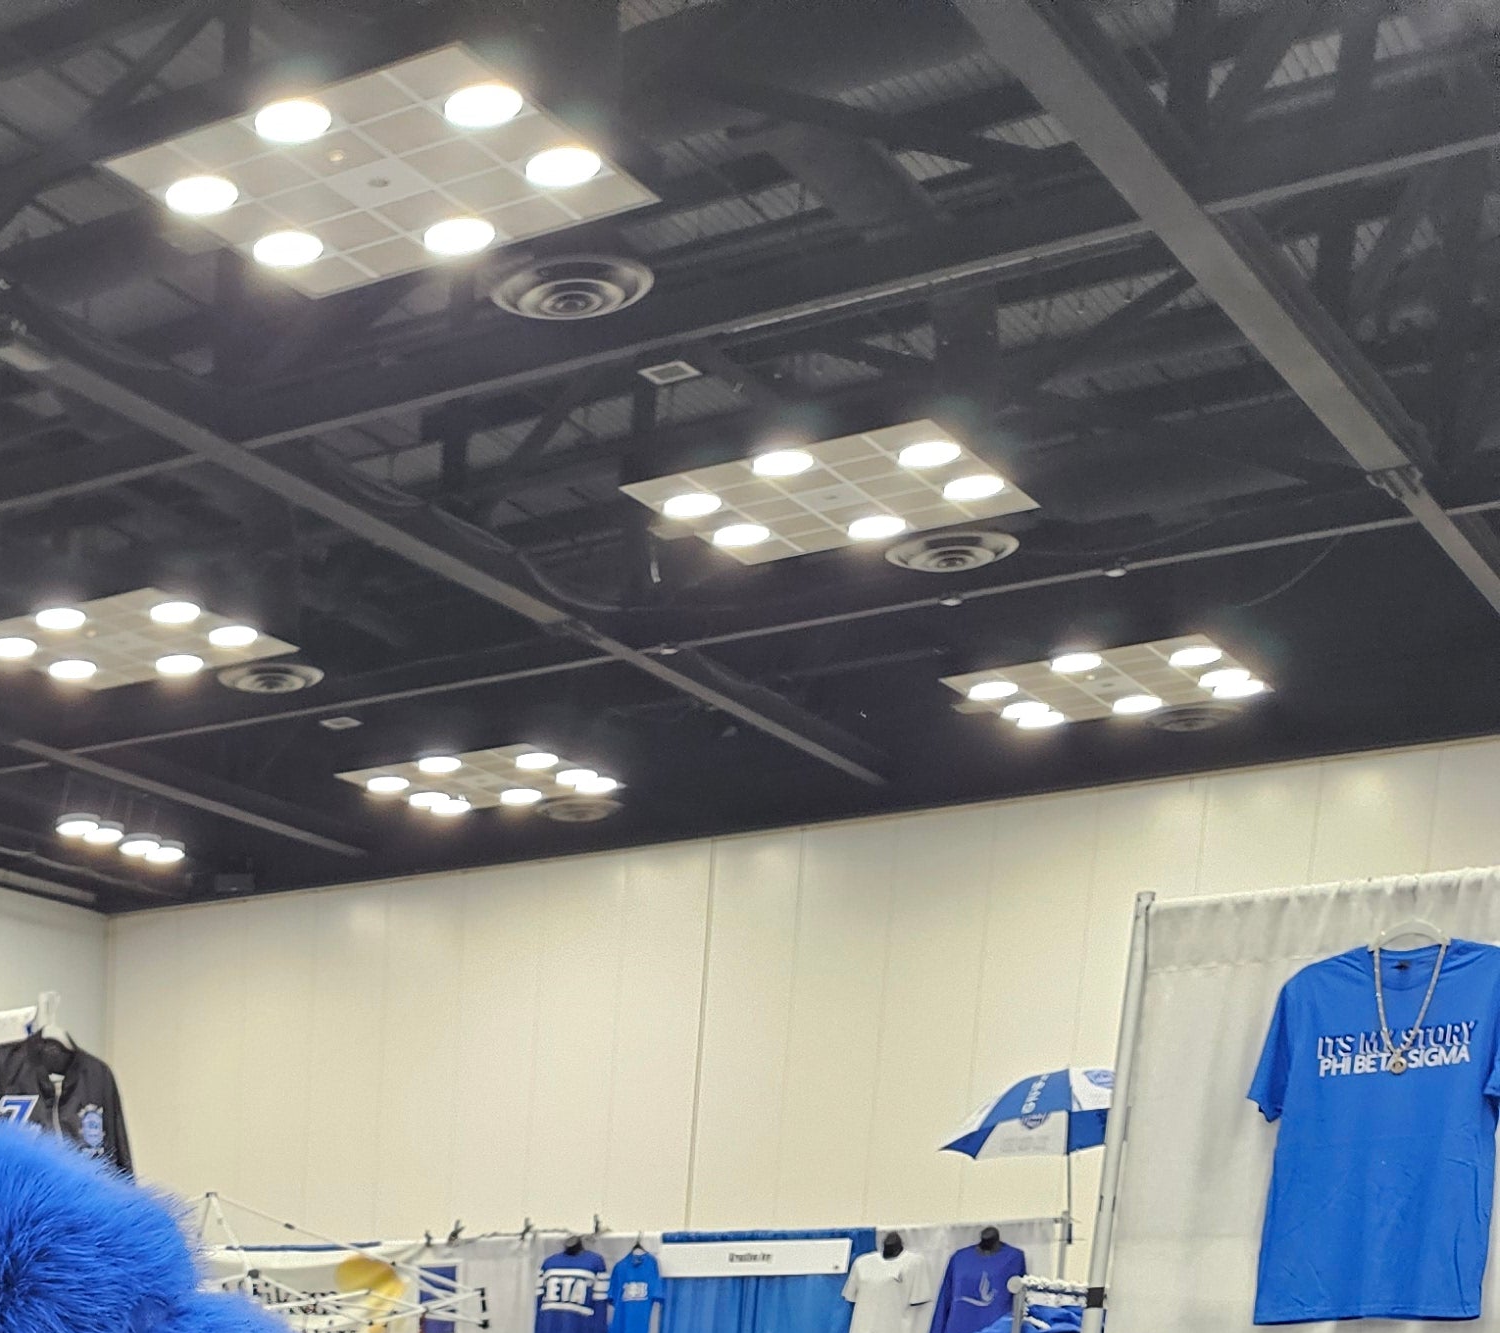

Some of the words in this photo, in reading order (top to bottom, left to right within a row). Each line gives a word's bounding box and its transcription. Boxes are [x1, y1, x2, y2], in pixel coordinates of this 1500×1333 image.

[1400, 1019, 1477, 1050] STORY
[1318, 1055, 1351, 1077] PHI
[1407, 1044, 1471, 1069] SIGMA
